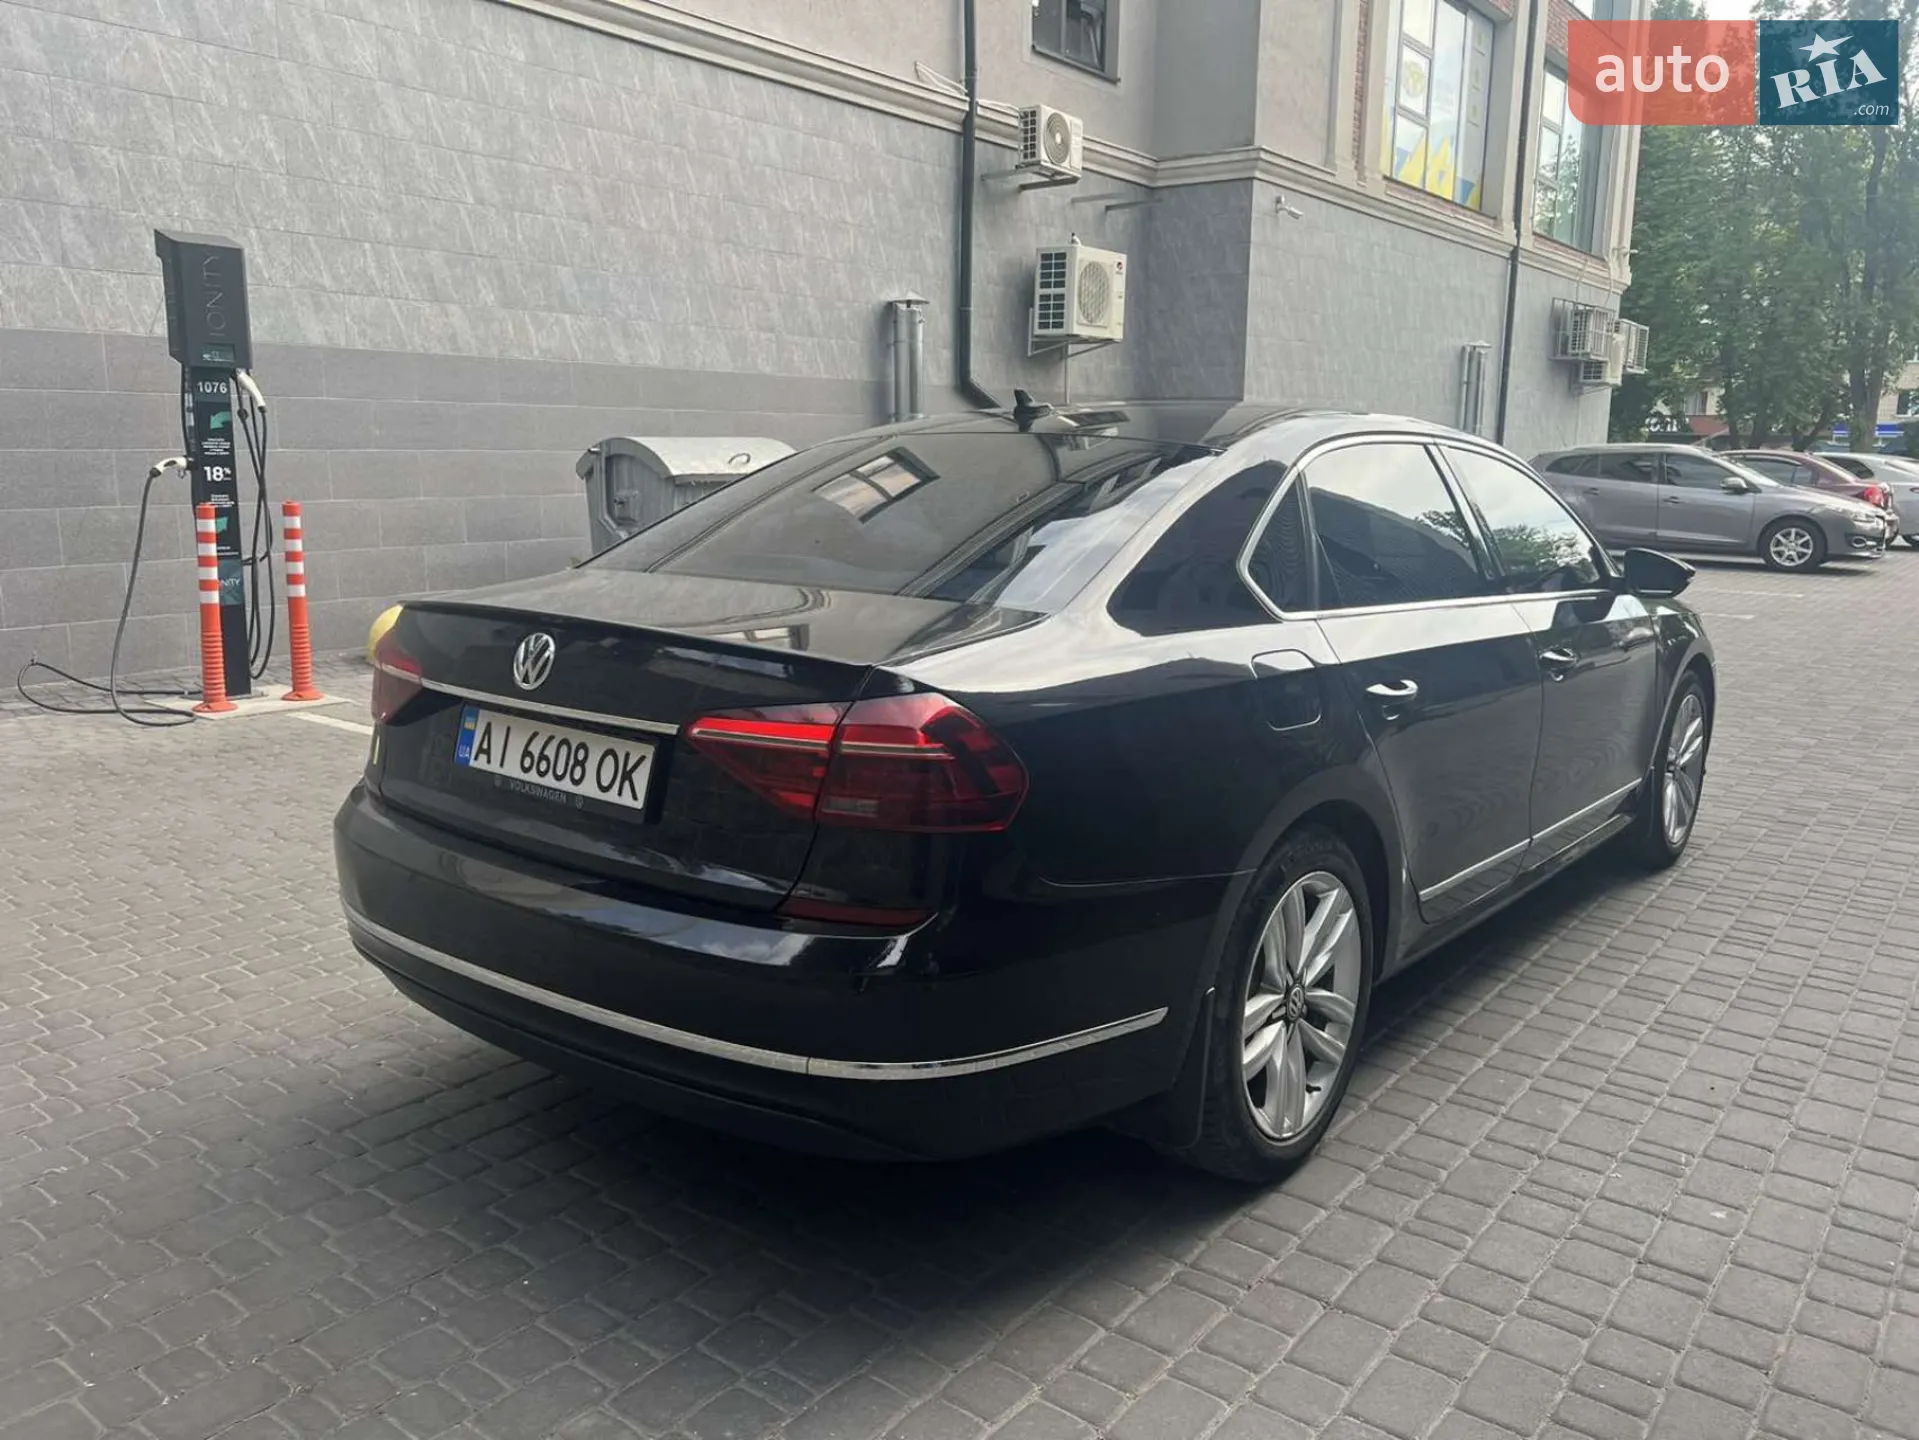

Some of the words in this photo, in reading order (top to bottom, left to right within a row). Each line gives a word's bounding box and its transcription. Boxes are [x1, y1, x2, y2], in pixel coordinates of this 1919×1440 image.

[197, 381, 228, 394] 1076
[474, 721, 511, 768] AI
[520, 731, 589, 786] 6608
[596, 748, 647, 801] OK
[508, 779, 567, 804] VOLKSWAGEN
